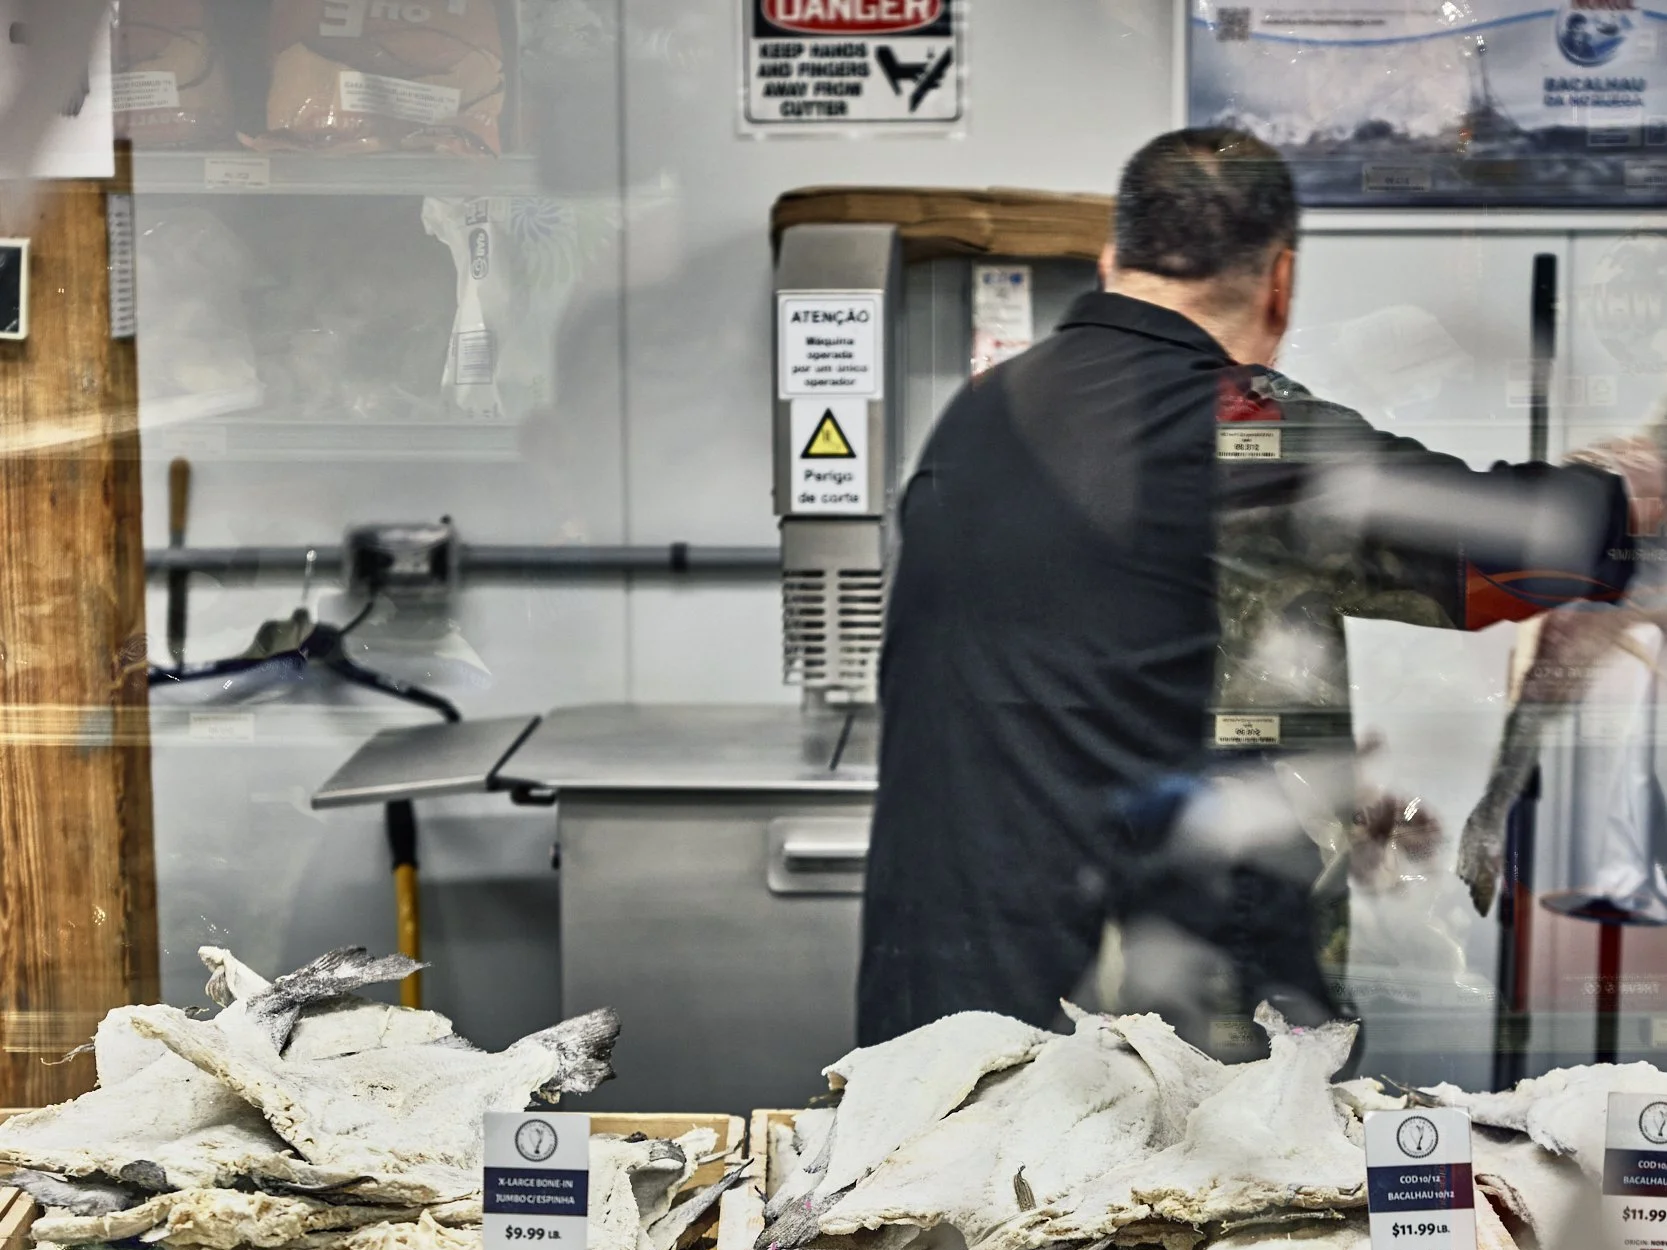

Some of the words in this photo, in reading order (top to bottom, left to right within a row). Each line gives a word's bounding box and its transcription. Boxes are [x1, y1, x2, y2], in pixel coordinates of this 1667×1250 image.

[776, 0, 929, 21] DANGER
[759, 43, 804, 58] KEEP
[809, 43, 868, 58] HANDS
[756, 62, 793, 78] AND
[798, 62, 870, 78] FINGERS
[762, 82, 807, 97] AWAY
[813, 82, 863, 97] FROM
[1544, 77, 1647, 92] BACALHAU
[779, 101, 848, 117] CUTTER
[790, 308, 870, 326] ATENÇÃO
[804, 469, 853, 484] Perigo
[798, 493, 816, 504] de
[821, 493, 860, 504] corte
[1638, 1160, 1656, 1169] COD
[498, 1177, 535, 1188] X-LARGE
[536, 1179, 574, 1188] BONE-IN
[1400, 1175, 1418, 1184] COD
[496, 1193, 526, 1203] JUMBO
[1388, 1191, 1433, 1201] BACALHAU
[1622, 1206, 1666, 1222] $11.99
[505, 1224, 545, 1240] $9.99
[1392, 1222, 1435, 1238] $11.99
[1437, 1225, 1450, 1233] LB.
